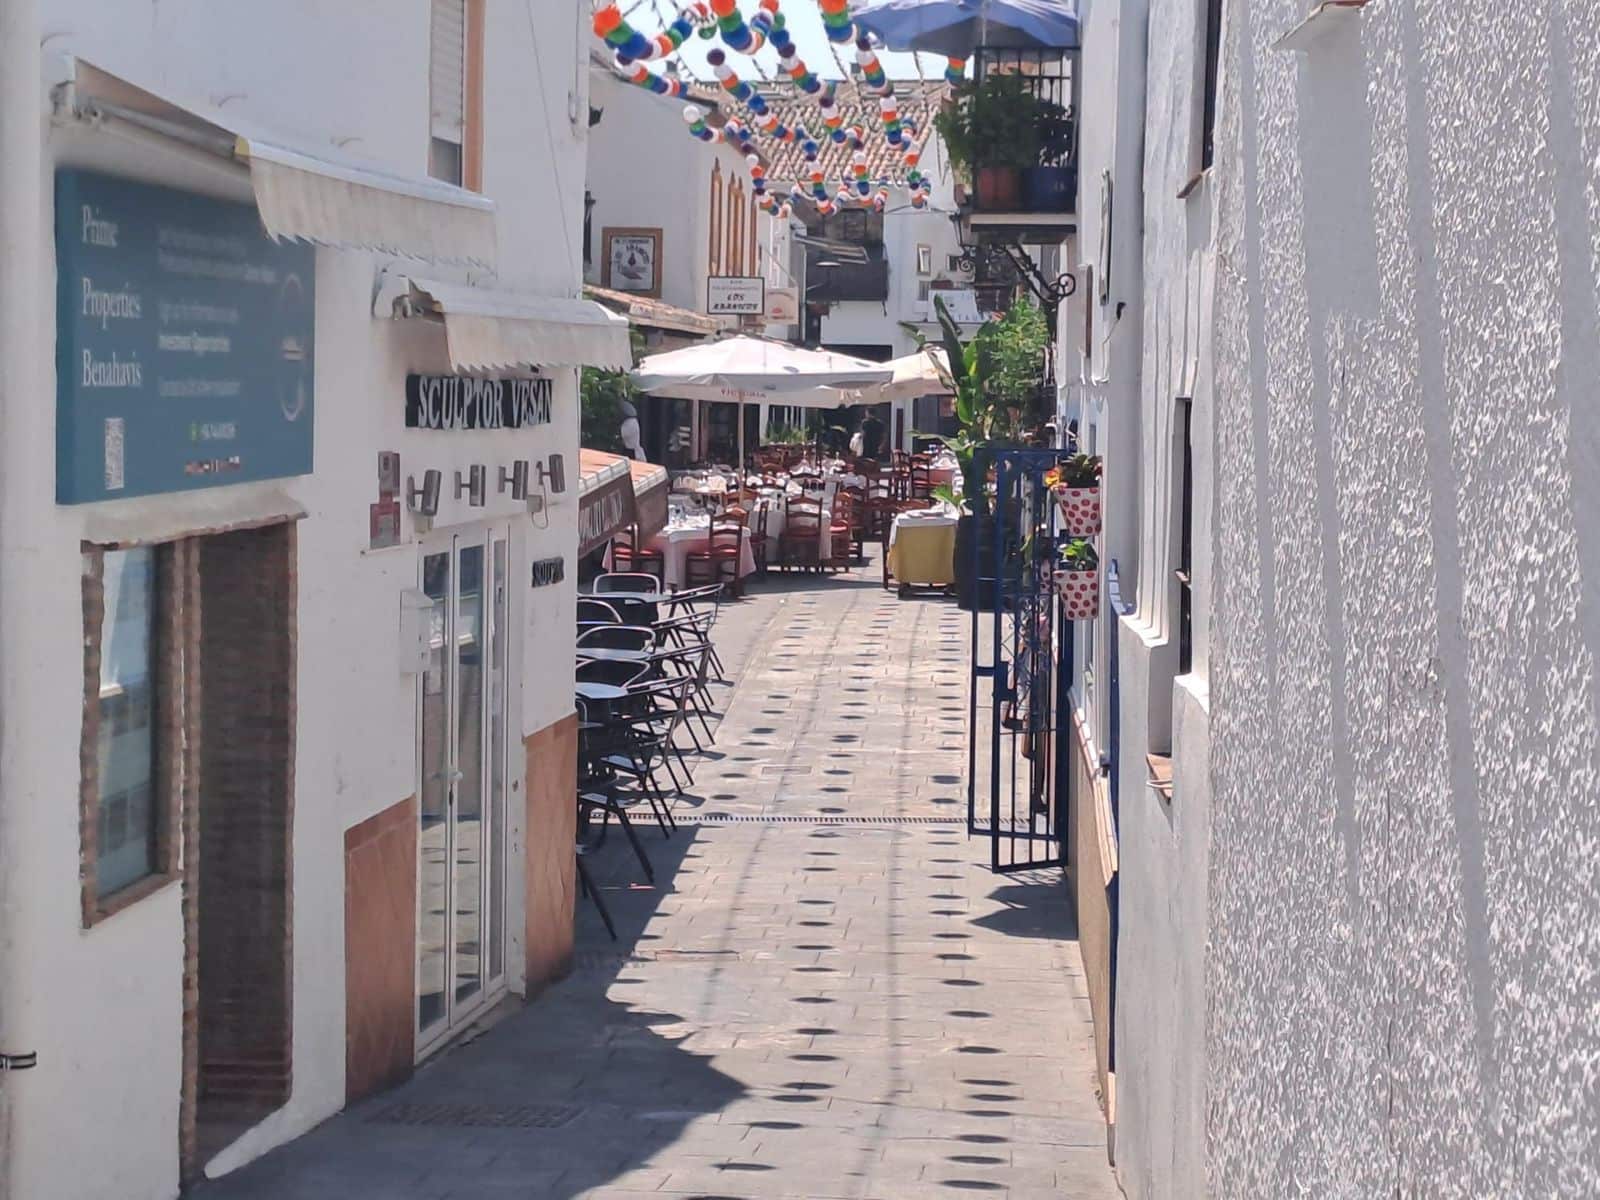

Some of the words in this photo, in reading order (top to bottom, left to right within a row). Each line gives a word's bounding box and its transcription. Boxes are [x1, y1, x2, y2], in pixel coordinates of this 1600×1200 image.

[82, 204, 118, 247] Prime
[82, 277, 141, 330] Properties
[82, 348, 142, 387] Benahavis
[418, 376, 504, 429] SCULPTOR
[511, 378, 552, 426] VESAN
